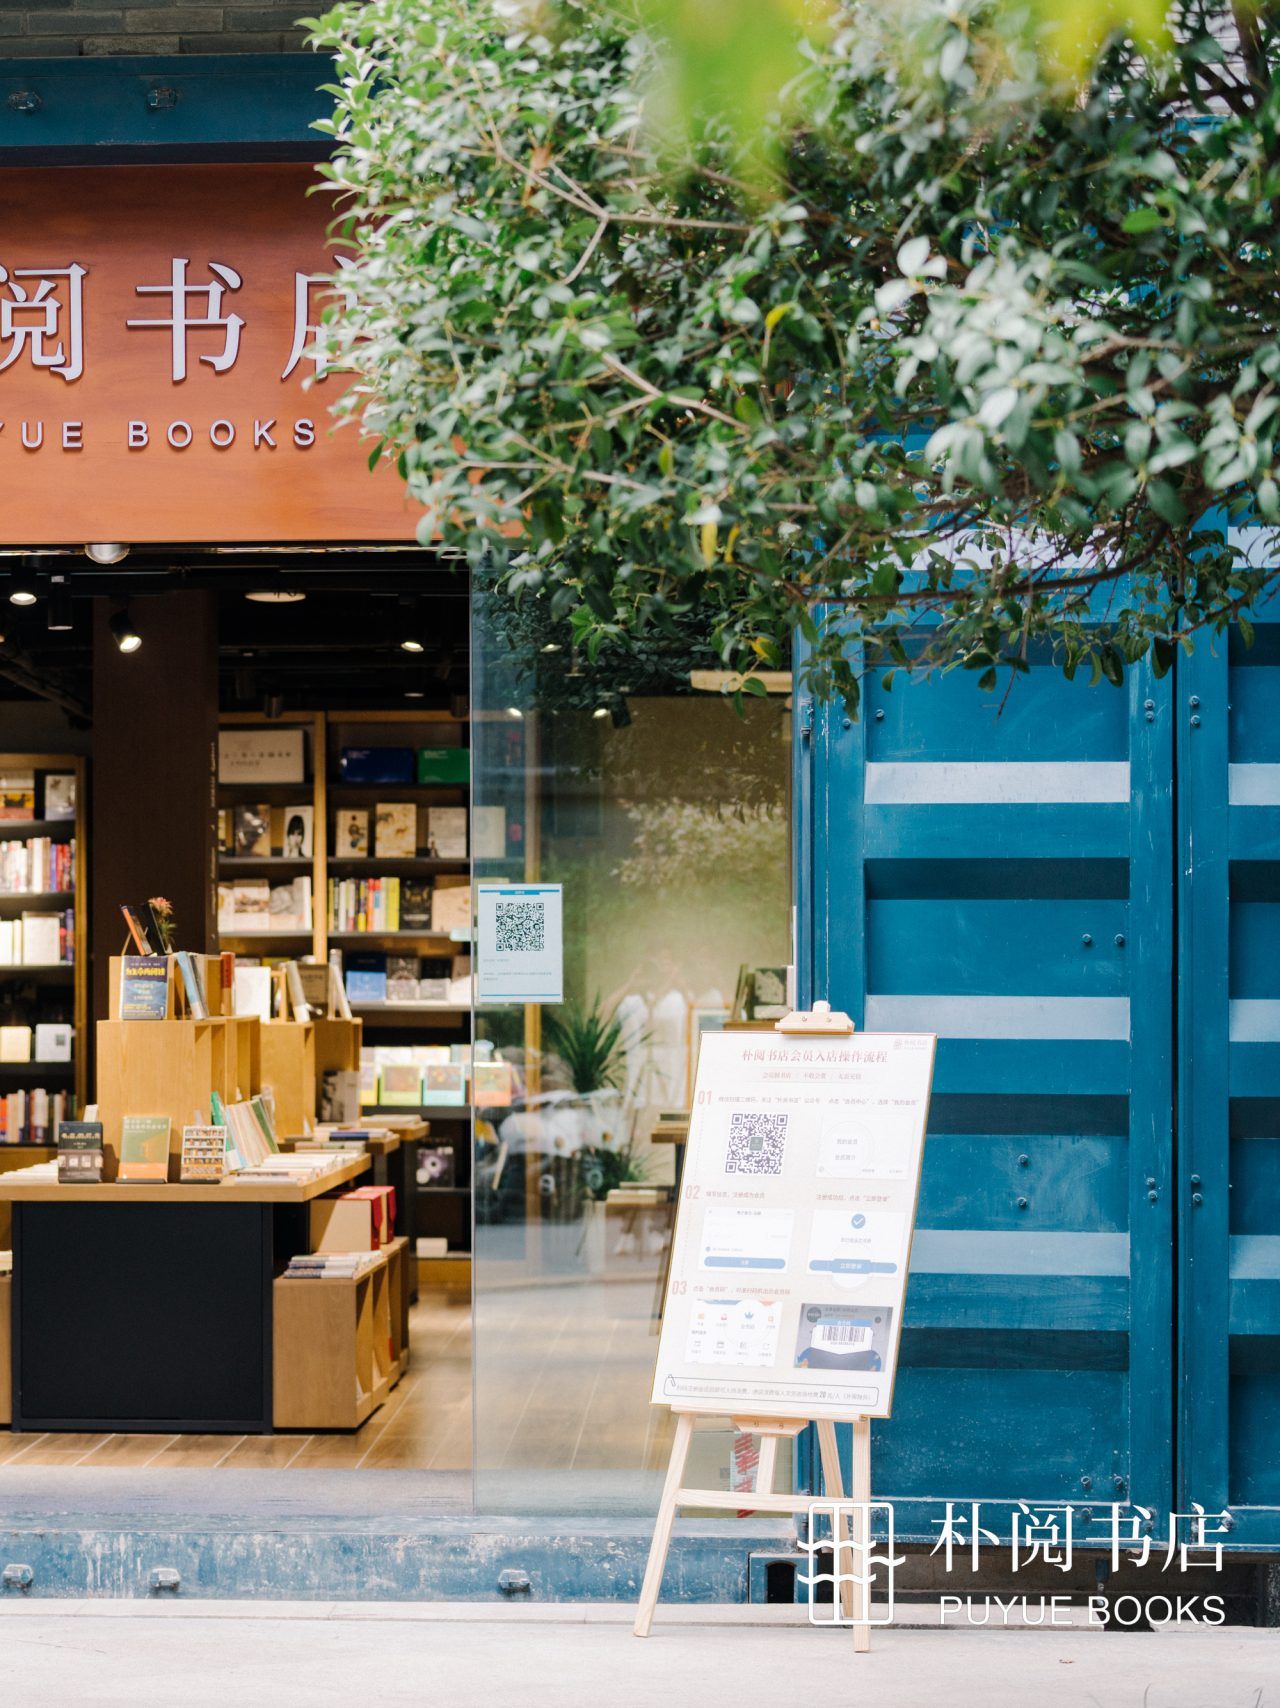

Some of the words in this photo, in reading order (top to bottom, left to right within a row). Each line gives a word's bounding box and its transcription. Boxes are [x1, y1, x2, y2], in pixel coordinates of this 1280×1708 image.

[126, 417, 317, 449] BOOKS
[742, 1048, 889, 1063] 朴阅书店会员入店操作流程
[697, 1089, 713, 1105] 01
[685, 1185, 700, 1200] 02
[671, 1280, 688, 1295] 03
